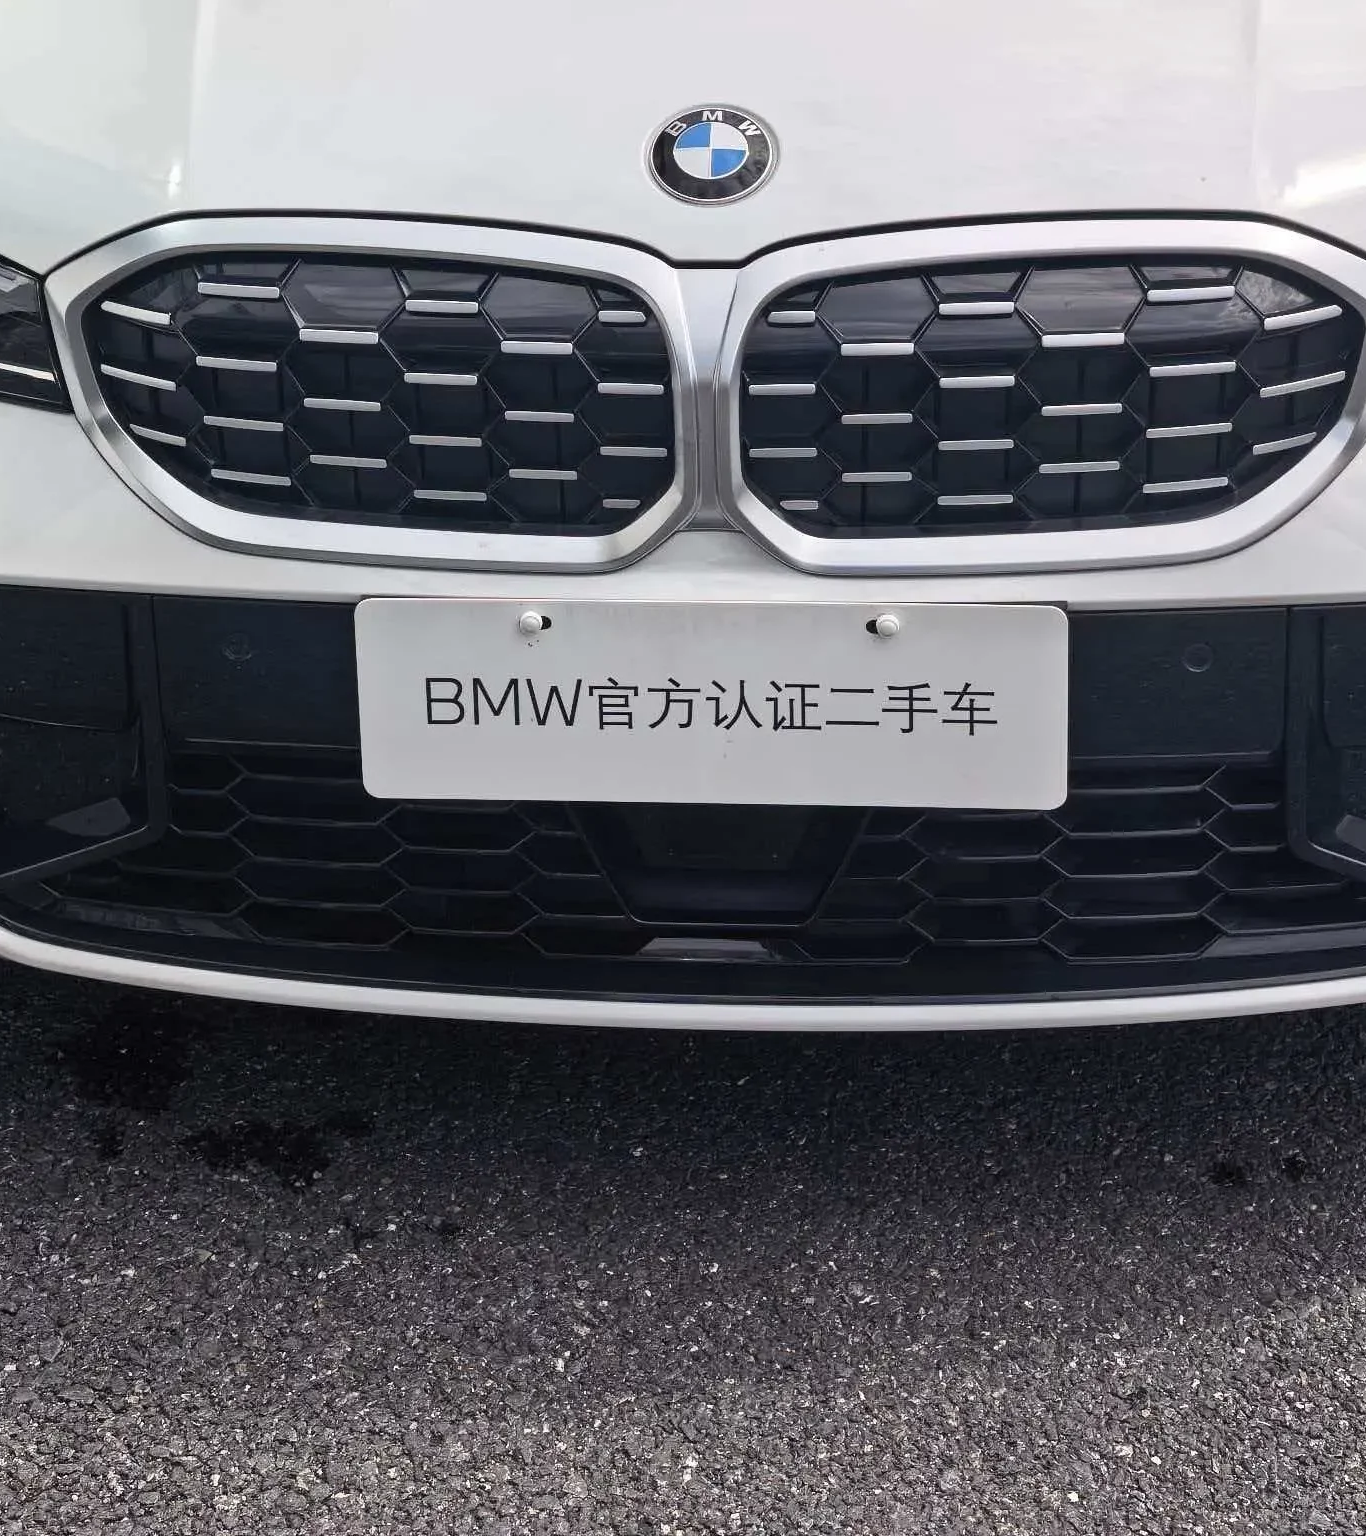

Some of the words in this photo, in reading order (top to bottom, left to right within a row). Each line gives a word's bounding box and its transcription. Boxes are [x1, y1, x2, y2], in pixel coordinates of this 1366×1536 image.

[666, 110, 761, 137] BMW
[425, 676, 998, 737] BMW官方认证二手车
